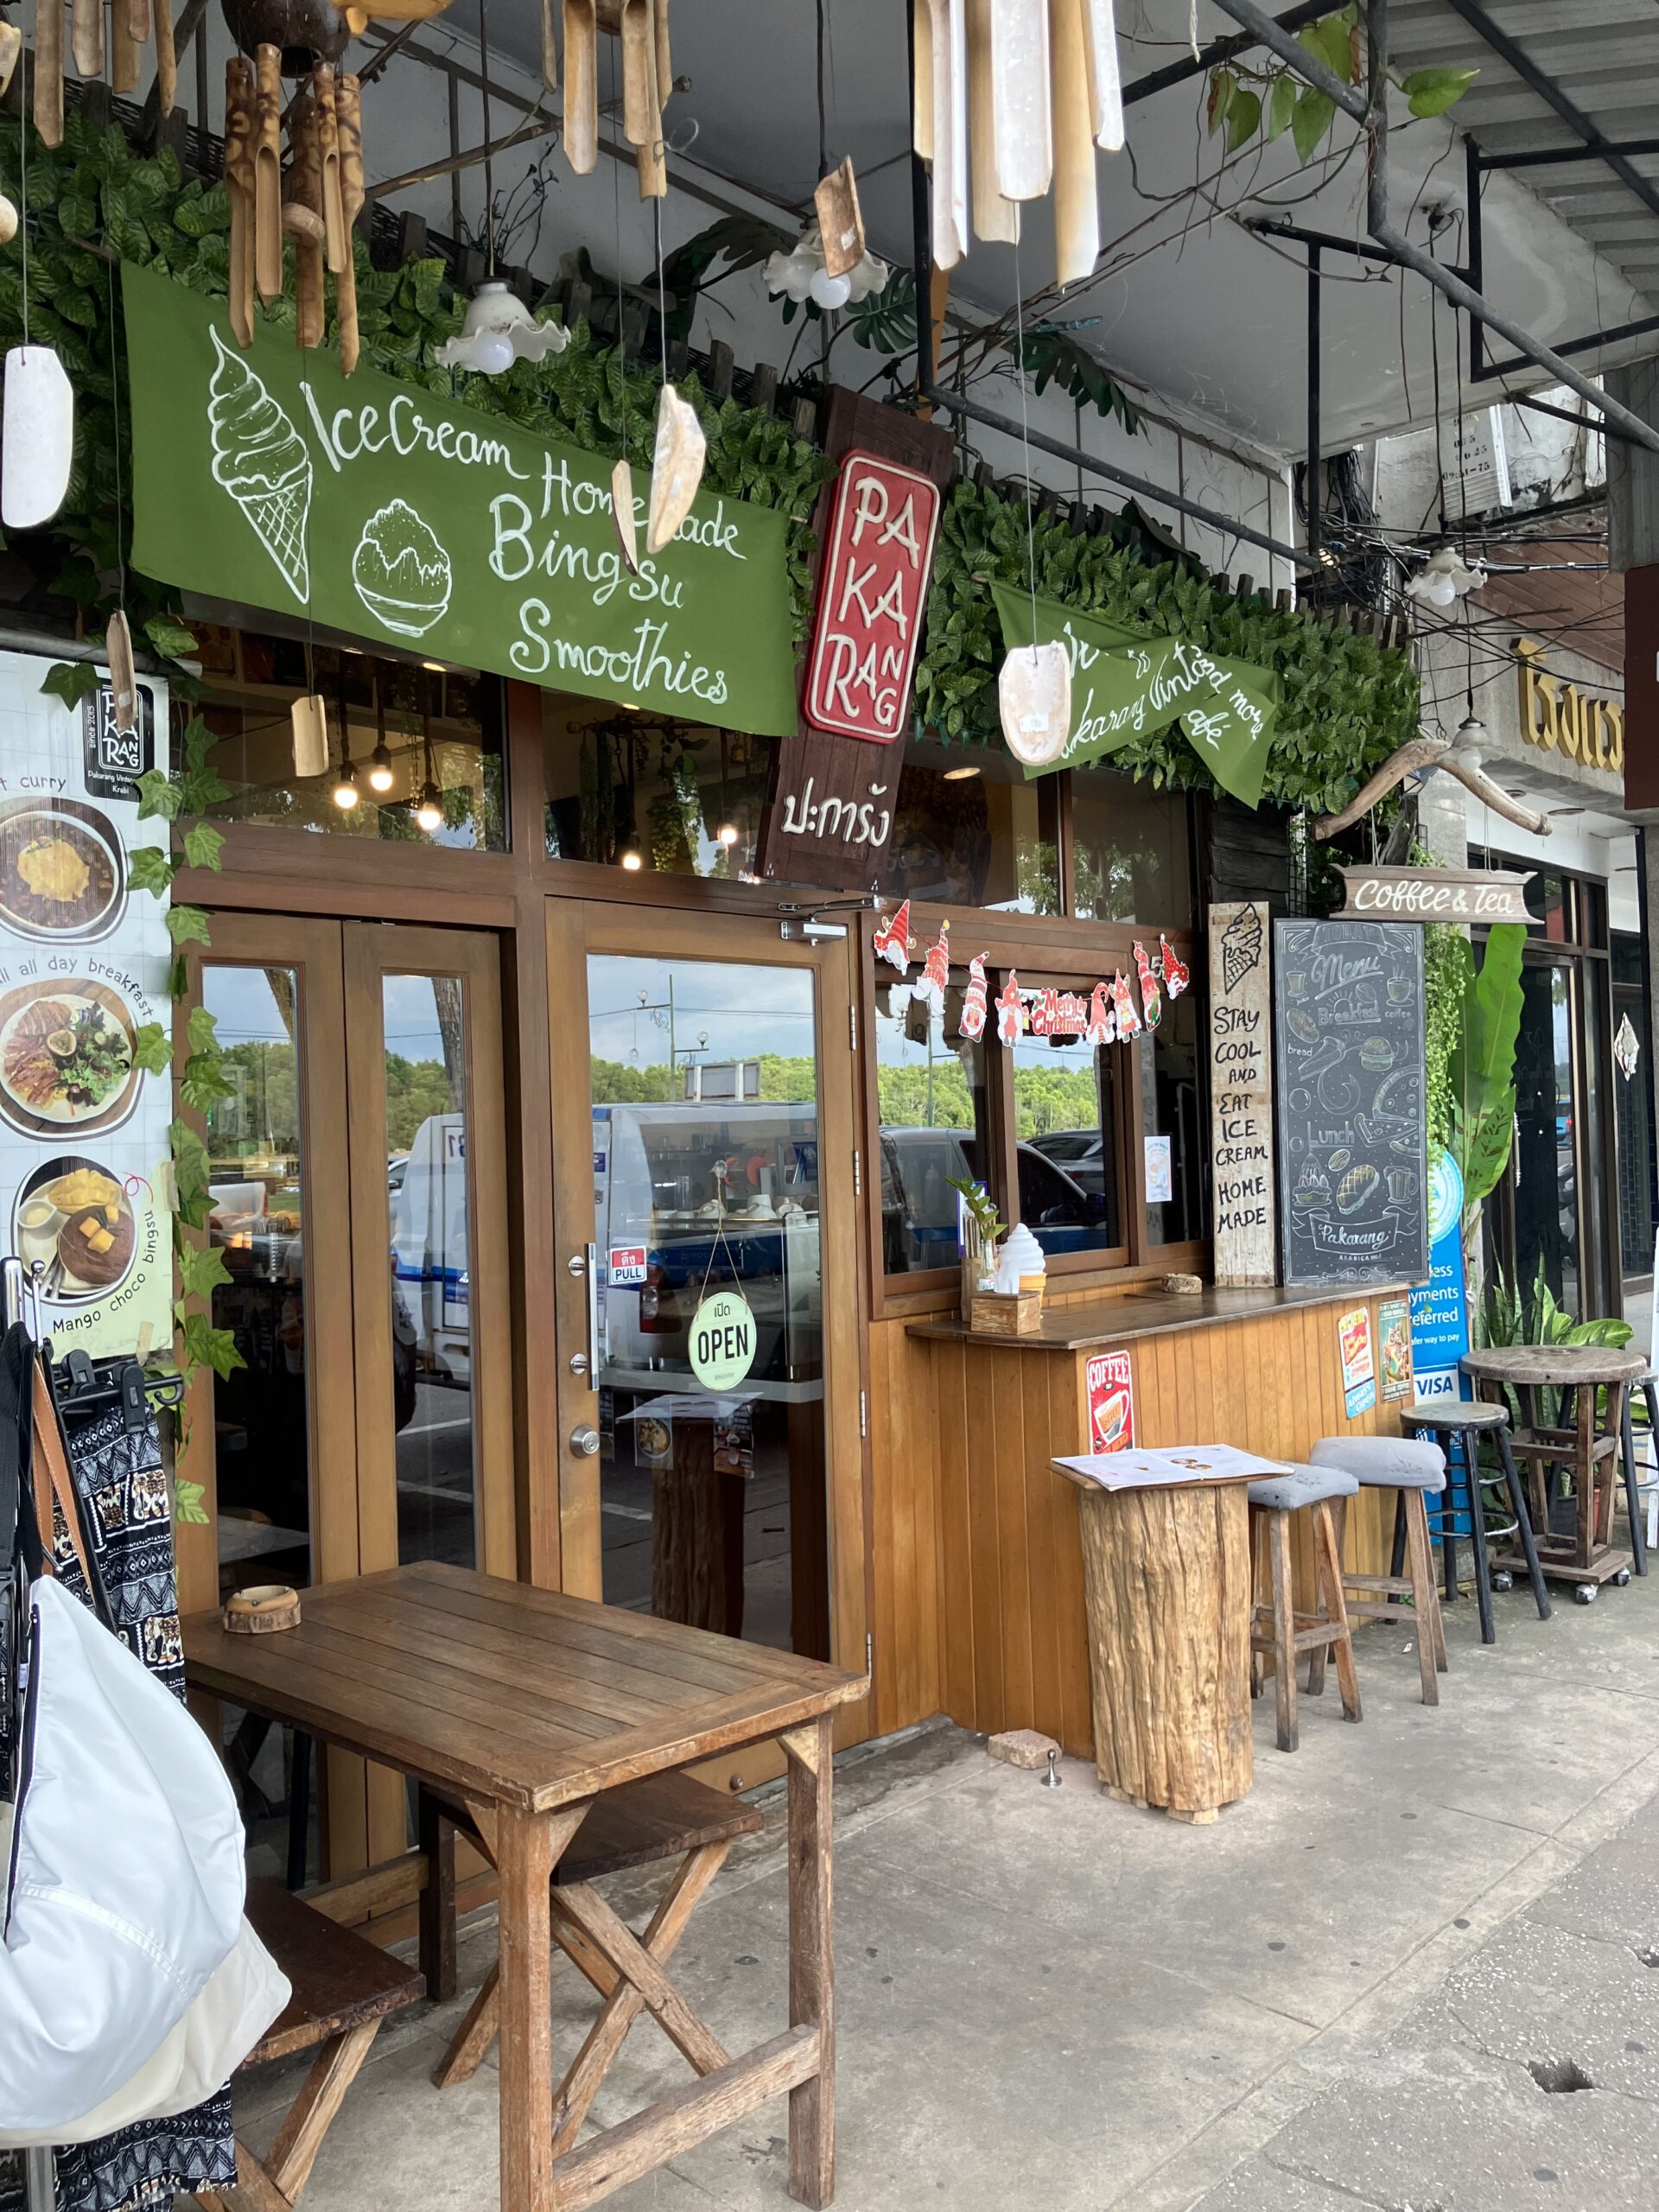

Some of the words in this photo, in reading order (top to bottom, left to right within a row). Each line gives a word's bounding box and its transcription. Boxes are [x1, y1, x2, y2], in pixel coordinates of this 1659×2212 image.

[852, 476, 920, 569] PA
[488, 493, 684, 609] Bingsu
[836, 556, 908, 640] KA
[509, 597, 728, 705] Smoothies
[1510, 637, 1624, 773] โรงแร
[20, 774, 67, 793] curry
[781, 776, 890, 848] ปะการัง
[1354, 879, 1451, 912] Coffee
[1452, 887, 1469, 913] &
[1473, 884, 1515, 914] Tea
[1322, 924, 1376, 943] TODAY
[1311, 953, 1382, 991] Menu
[19, 959, 38, 976] all
[48, 955, 78, 974] day
[88, 957, 154, 1018] breakfast
[1040, 988, 1084, 1019] Merry
[1029, 1008, 1088, 1036] Christmas
[1213, 1006, 1260, 1037] STAY
[1214, 1041, 1262, 1065] COOL
[1287, 1043, 1313, 1057] bread
[1228, 1067, 1257, 1085] AND
[1218, 1093, 1253, 1116] EAT
[1221, 1118, 1258, 1144] ICE
[1306, 1120, 1355, 1145] Lunch
[1215, 1146, 1268, 1166] CREAM
[1217, 1175, 1268, 1206] HOME
[1217, 1207, 1268, 1236] MADE
[1318, 1224, 1389, 1250] Pakarang
[53, 1309, 102, 1335] Mango
[109, 1272, 147, 1313] choco
[143, 1210, 159, 1263] bingsu
[615, 1267, 642, 1281] PULL
[714, 1301, 731, 1318] เปิด
[1408, 1286, 1459, 1307] yments
[697, 1323, 748, 1364] OPEN
[1424, 1336, 1438, 1344] way
[1447, 1333, 1459, 1343] pay
[1089, 1355, 1129, 1393] COFFEE
[1416, 1376, 1453, 1396] VISA
